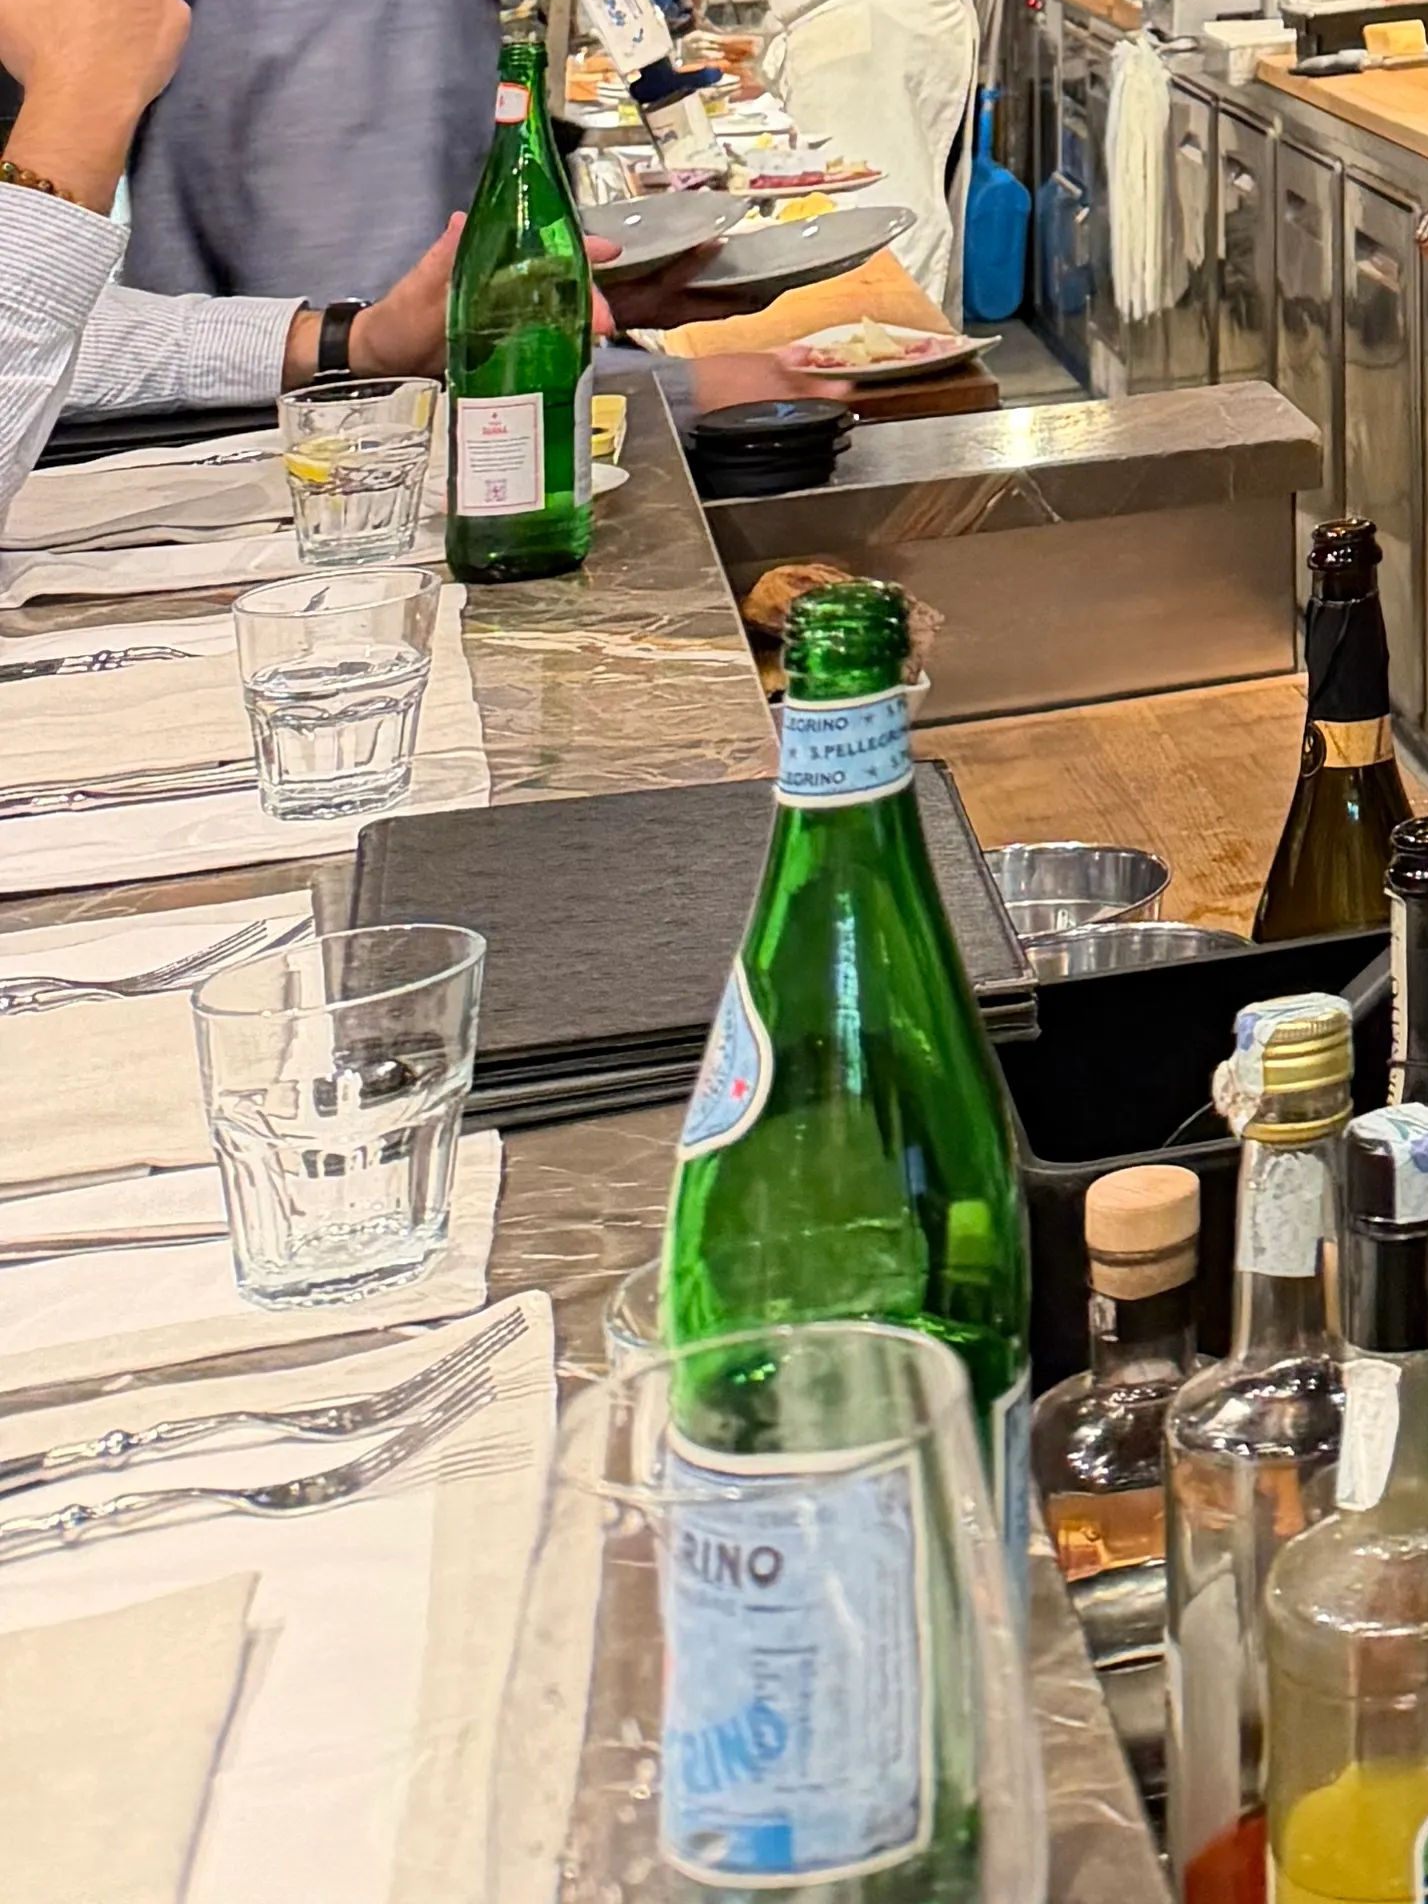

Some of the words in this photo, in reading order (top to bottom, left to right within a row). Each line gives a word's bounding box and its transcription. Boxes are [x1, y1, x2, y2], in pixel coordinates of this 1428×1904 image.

[784, 715, 849, 733] EGRINO
[809, 725, 909, 761] S.PELLEGR
[781, 769, 846, 787] EGRINO
[679, 1532, 785, 1589] RINO
